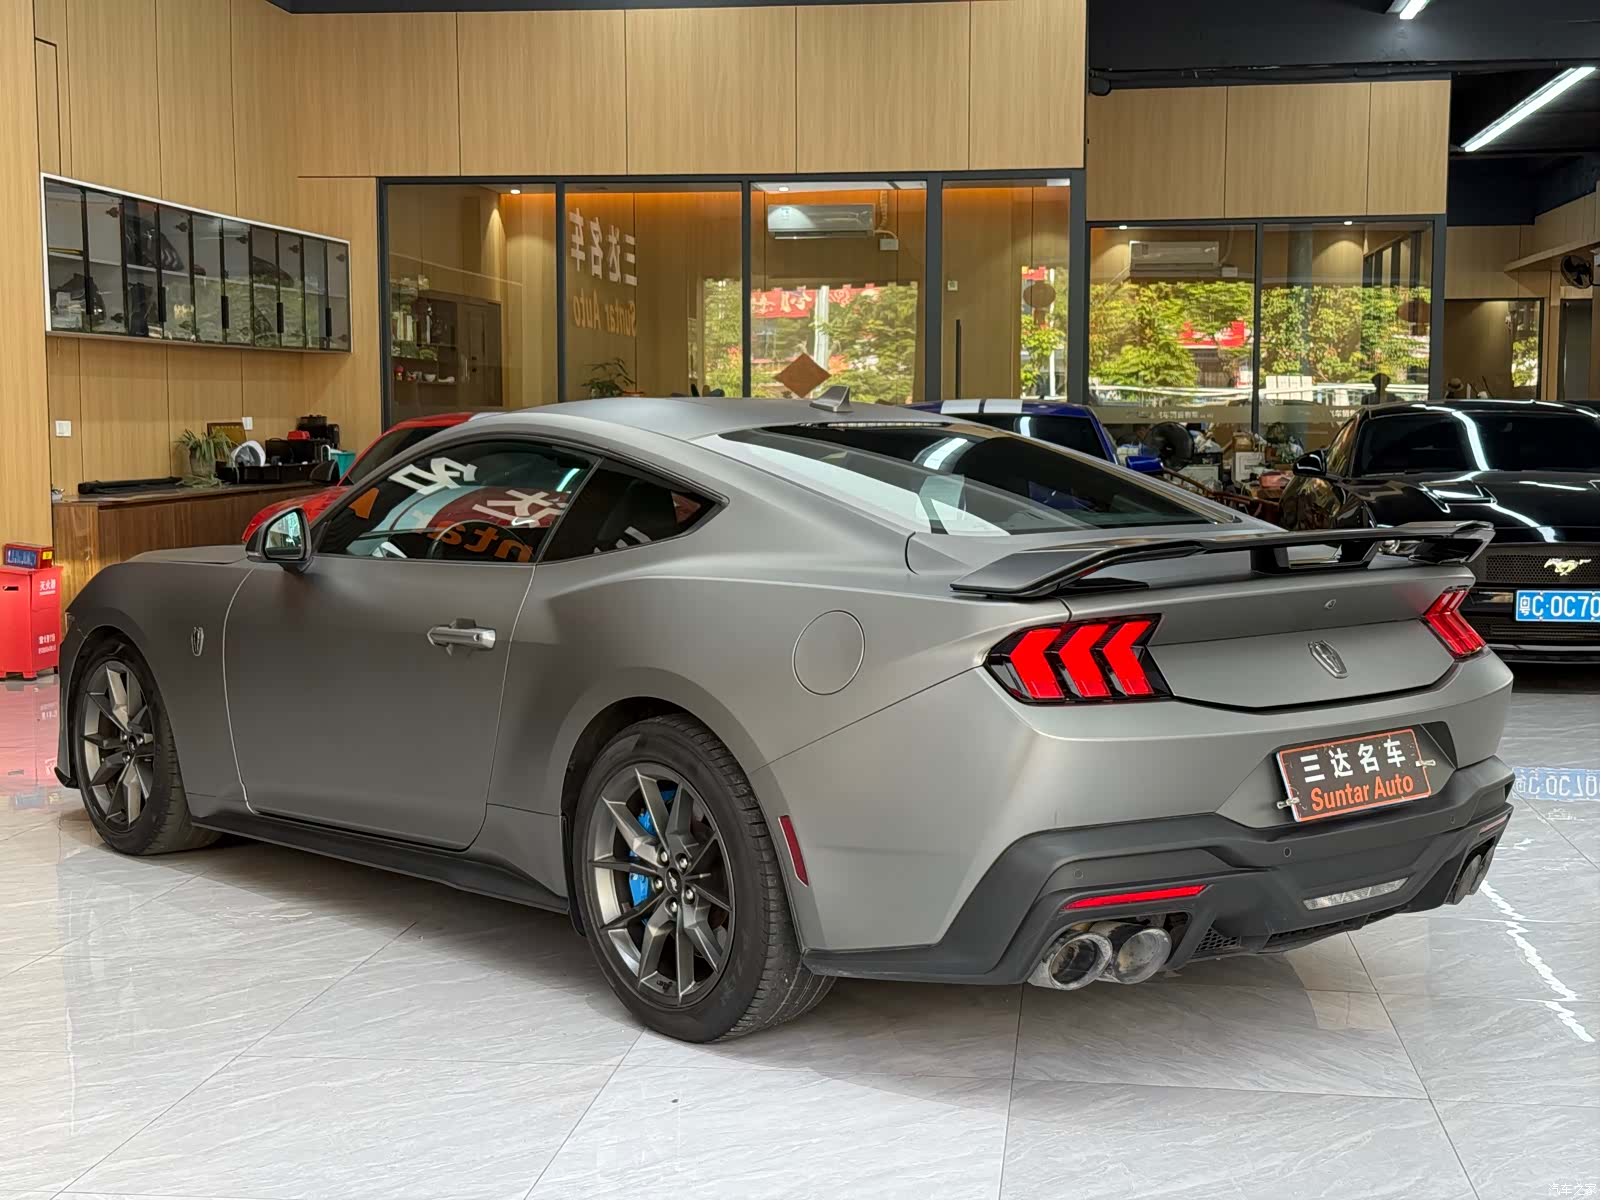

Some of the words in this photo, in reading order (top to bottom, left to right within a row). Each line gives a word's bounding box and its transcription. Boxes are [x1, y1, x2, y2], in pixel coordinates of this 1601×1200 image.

[1300, 738, 1406, 783] 三达名车
[1310, 783, 1370, 812] Suntar
[1374, 773, 1414, 800] Auto
